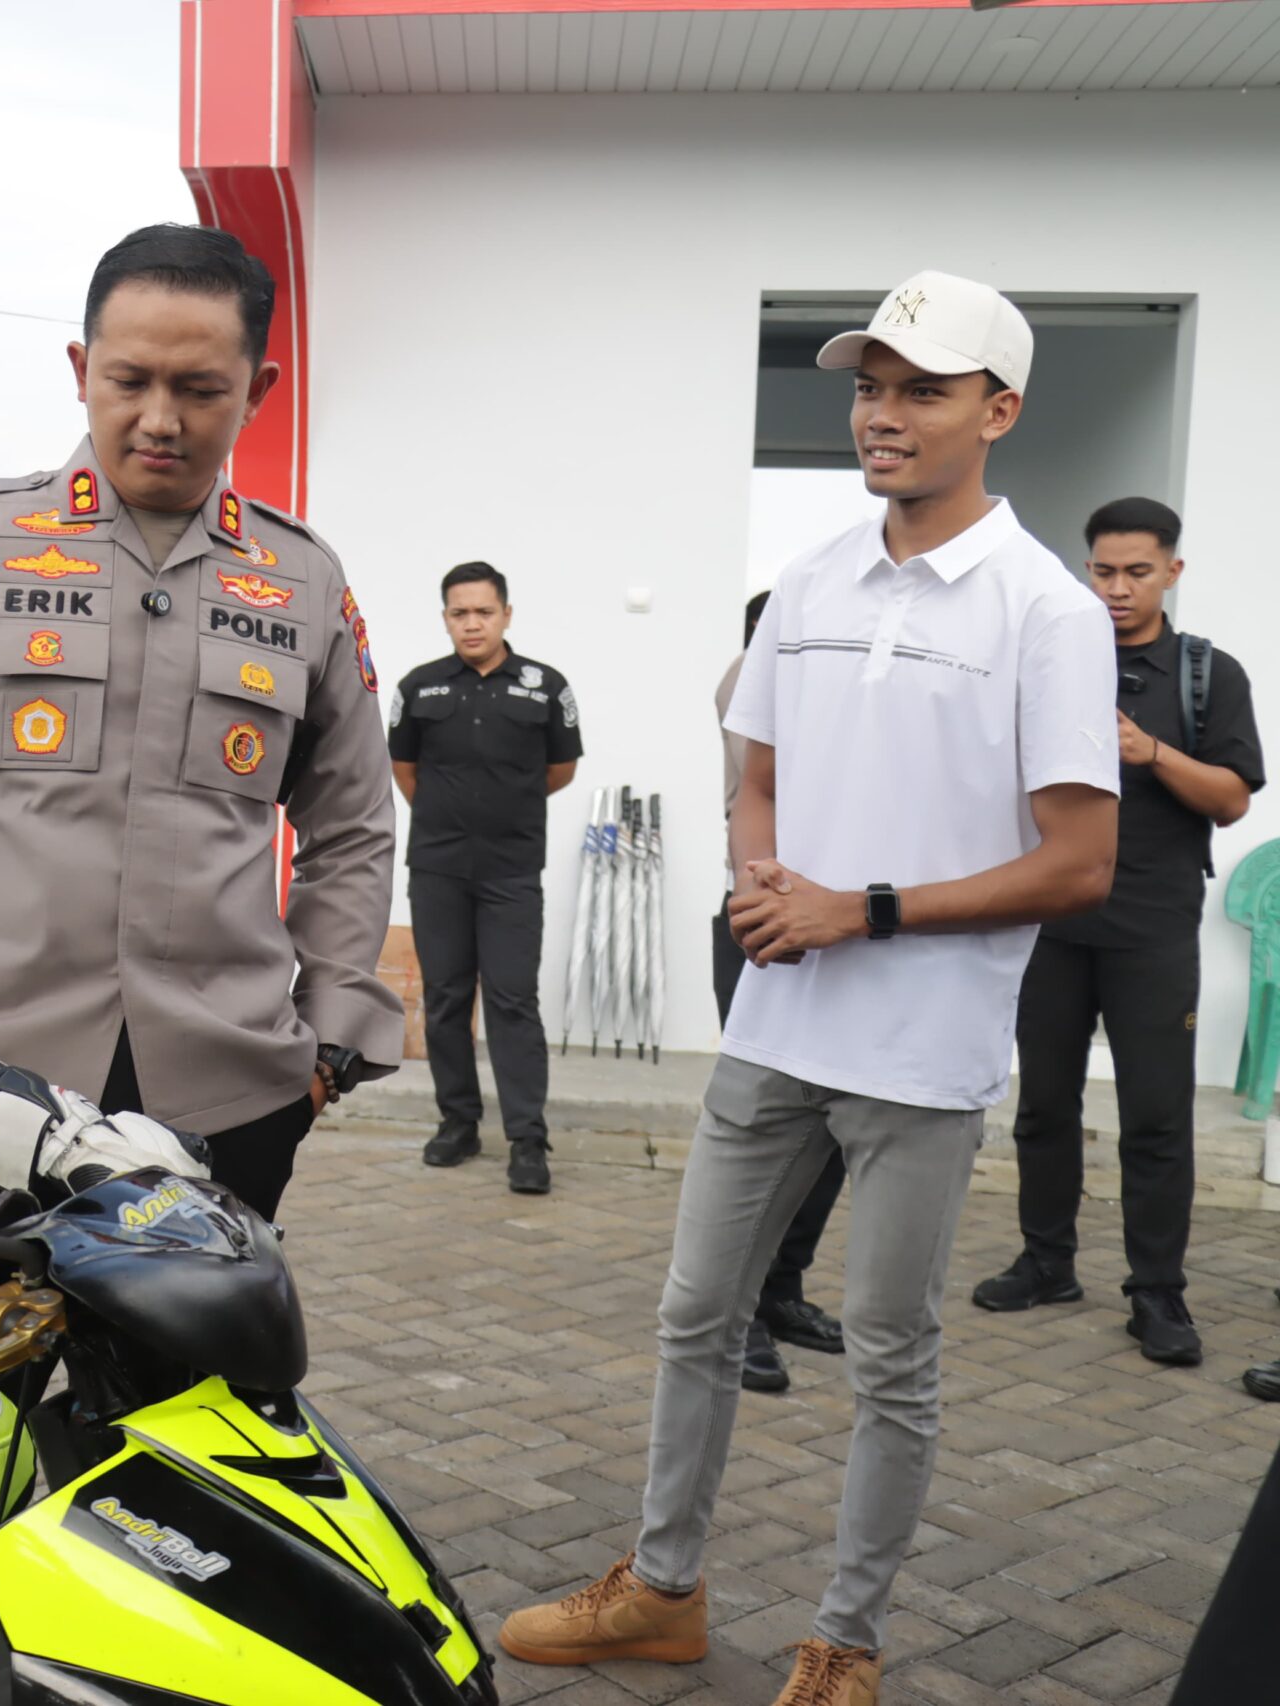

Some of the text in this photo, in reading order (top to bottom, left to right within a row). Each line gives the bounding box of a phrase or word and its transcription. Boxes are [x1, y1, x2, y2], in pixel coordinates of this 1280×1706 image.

[4, 588, 93, 616] ERIK
[210, 607, 297, 651] POLRI
[419, 686, 451, 698] NICO
